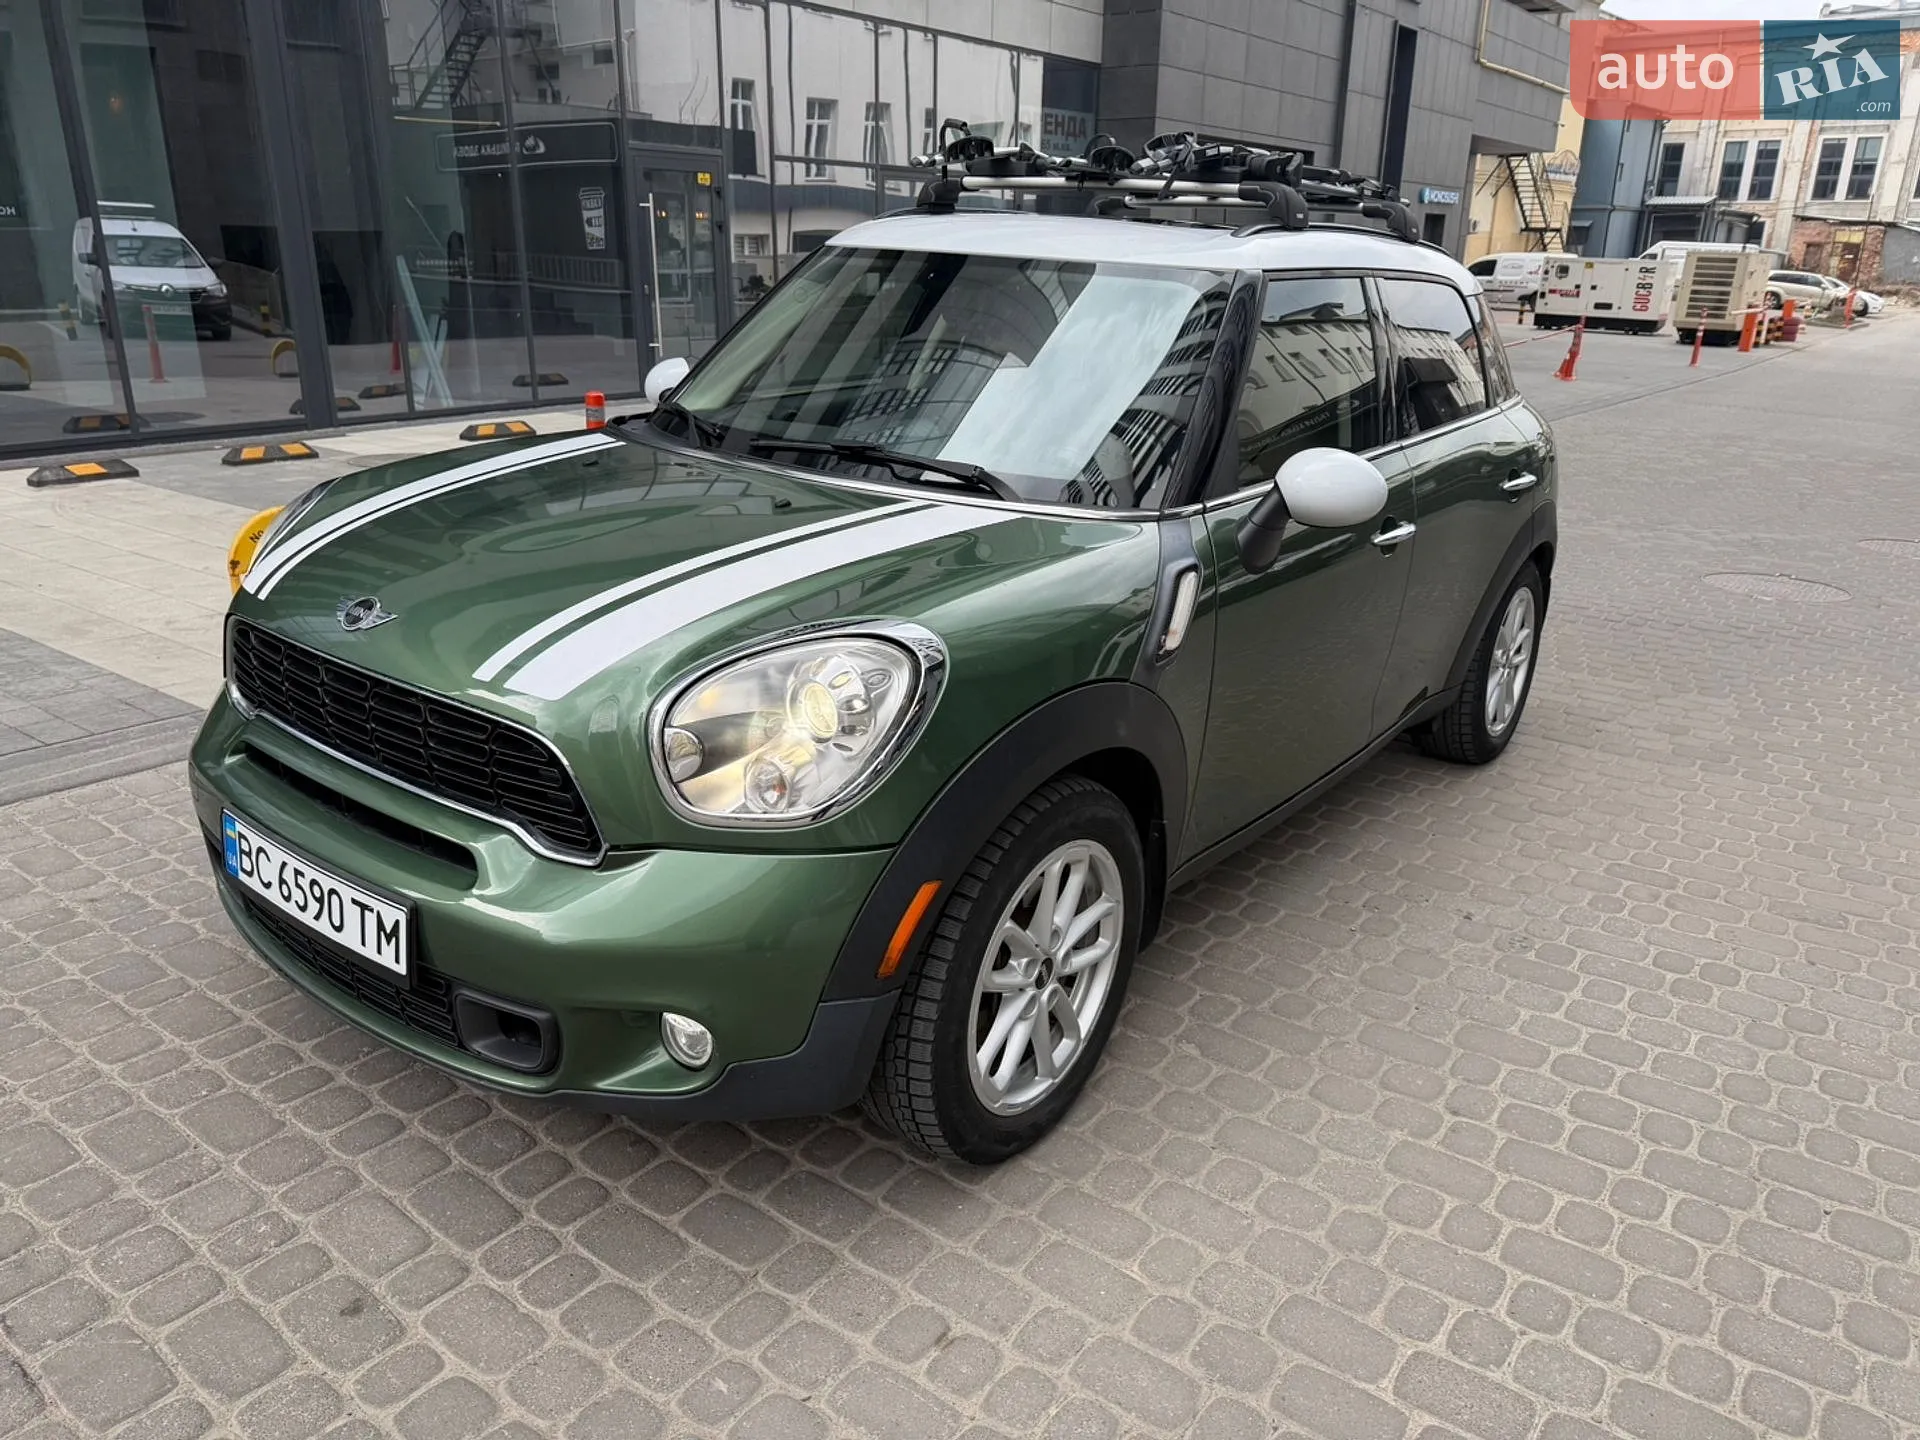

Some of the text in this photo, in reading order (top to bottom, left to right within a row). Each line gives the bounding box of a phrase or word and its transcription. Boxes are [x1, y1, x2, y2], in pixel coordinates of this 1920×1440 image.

[238, 830, 400, 965] BC 6590 TM
